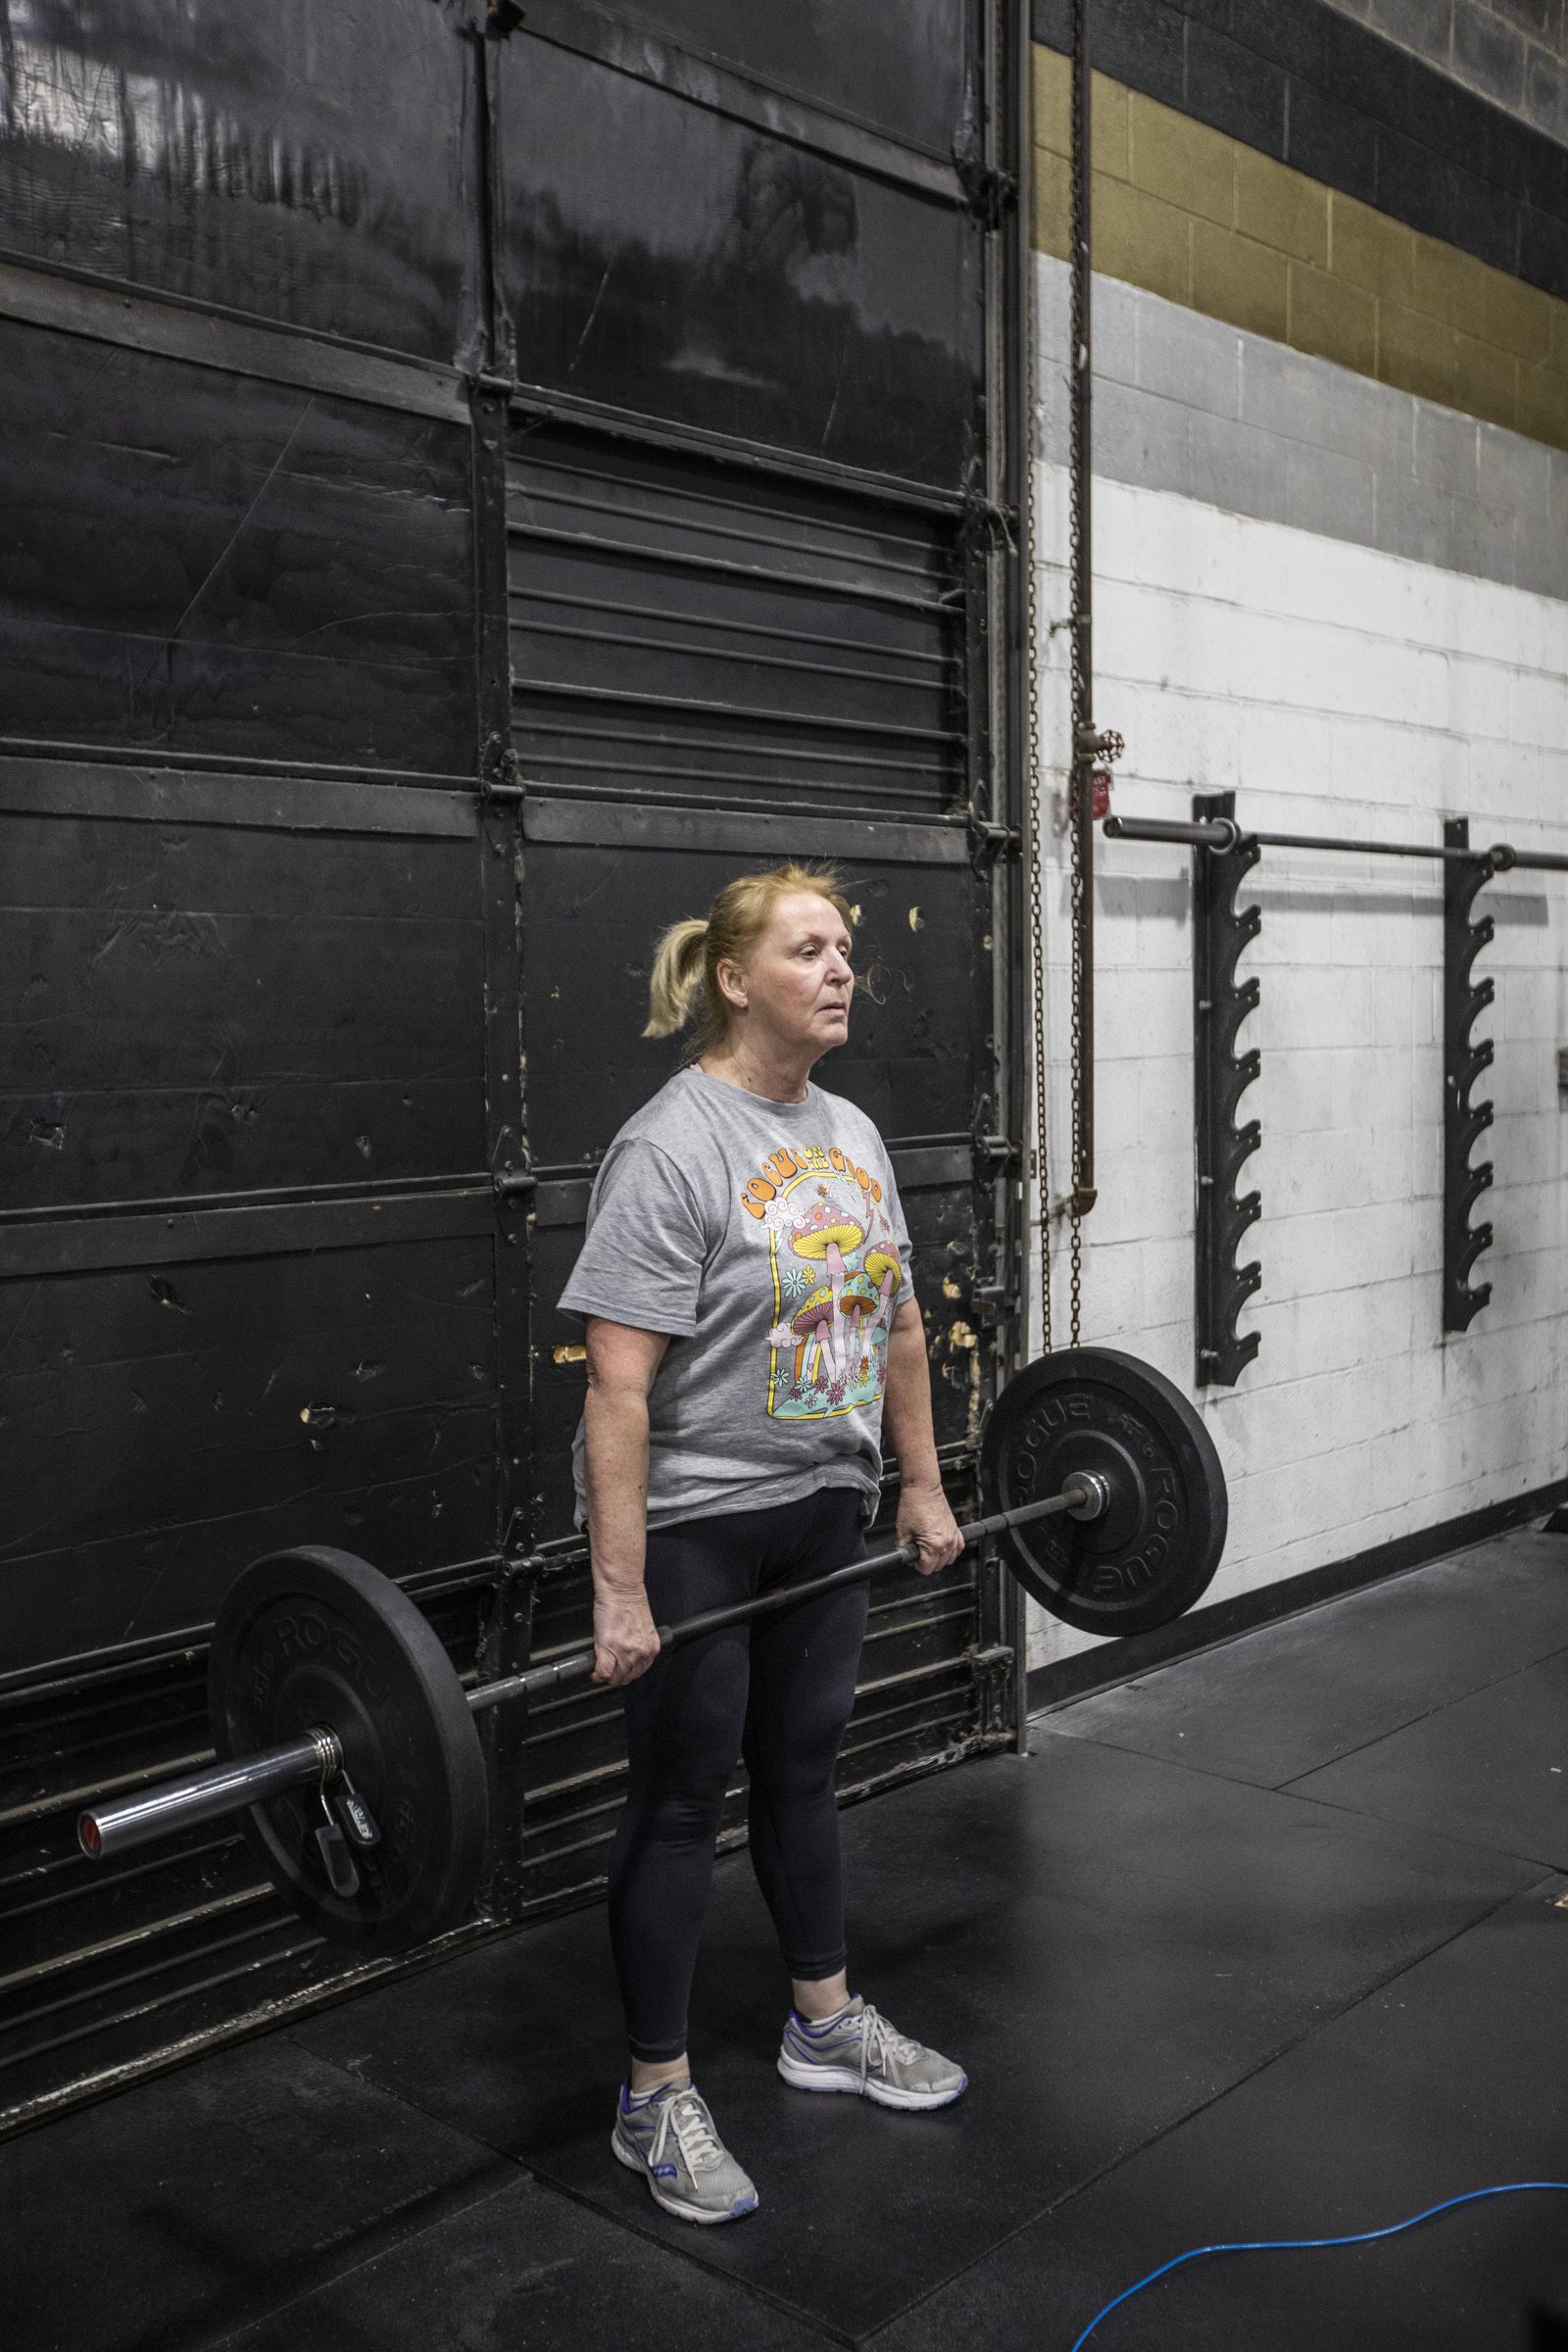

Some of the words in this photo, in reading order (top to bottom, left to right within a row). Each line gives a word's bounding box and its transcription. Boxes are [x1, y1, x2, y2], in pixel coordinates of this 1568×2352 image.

[804, 1146, 825, 1158] ON
[808, 1158, 829, 1170] THE
[829, 1148, 882, 1203] GOOD
[741, 1147, 808, 1219] FOCUS
[1093, 1467, 1179, 1594] ROGUE
